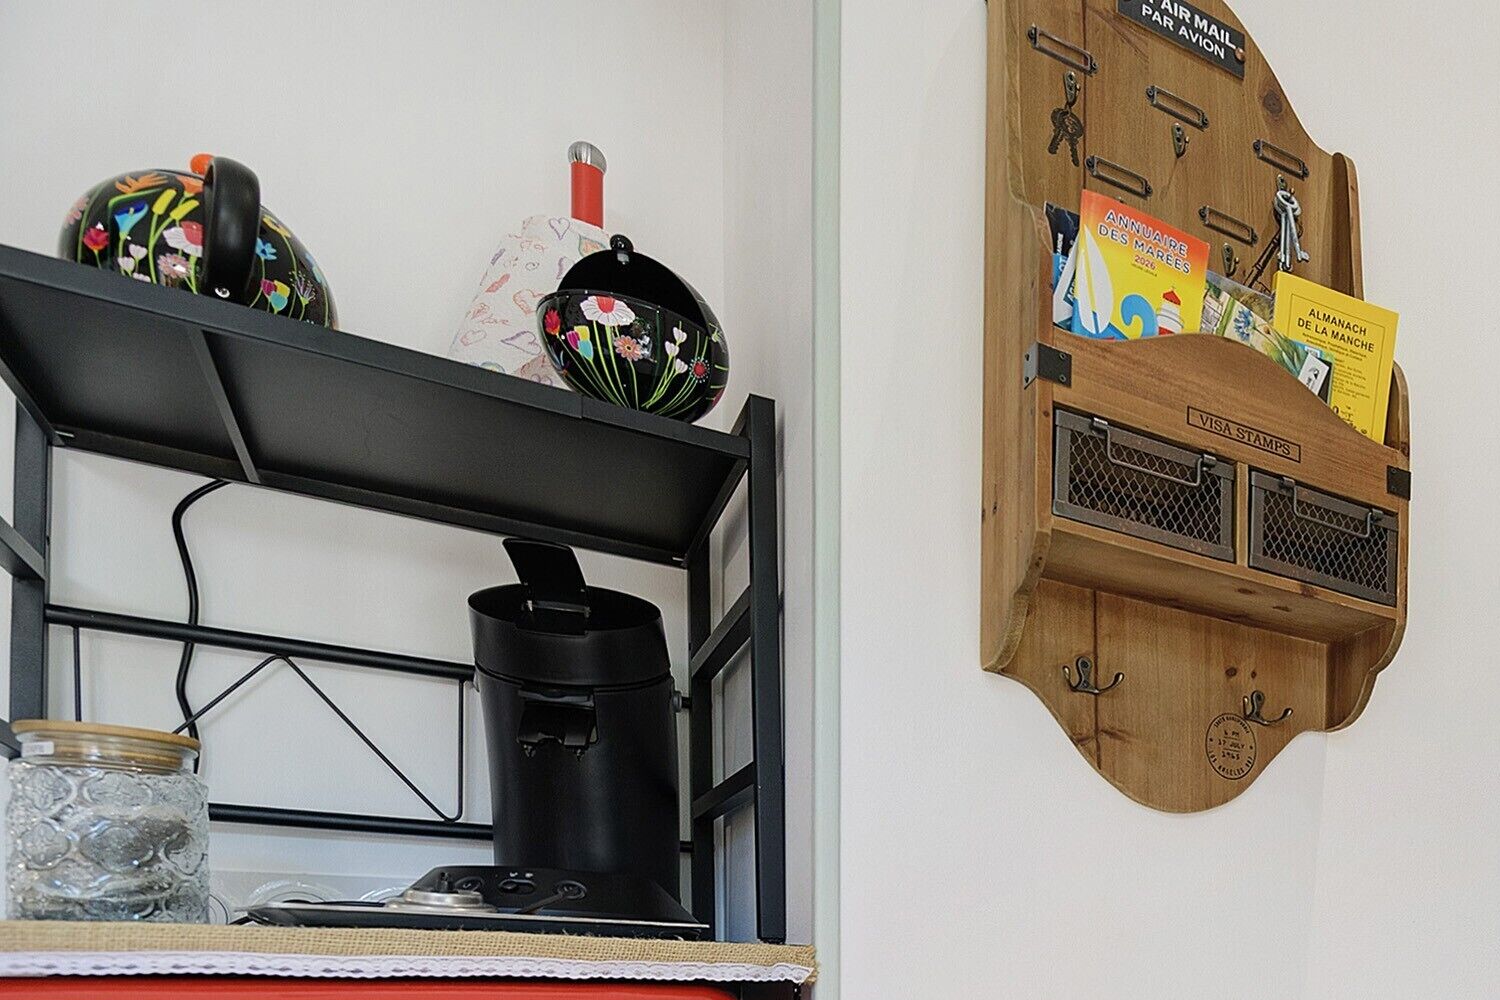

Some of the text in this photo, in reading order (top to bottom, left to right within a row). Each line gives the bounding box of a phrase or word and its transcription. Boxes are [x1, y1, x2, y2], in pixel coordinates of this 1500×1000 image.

[1141, 4, 1225, 59] PAR AVION
[1161, 0, 1237, 49] AIR MAIL
[1098, 224, 1129, 245] DES
[1134, 238, 1191, 274] MARÉES
[1106, 210, 1188, 257] ANNUAIRE
[1134, 255, 1156, 270] 2026
[1297, 317, 1312, 330] DE
[1315, 324, 1328, 337] LA
[1331, 330, 1375, 353] MANCHE
[1308, 308, 1367, 336] ALMANACH
[1200, 414, 1291, 455] VISA STAMPS
